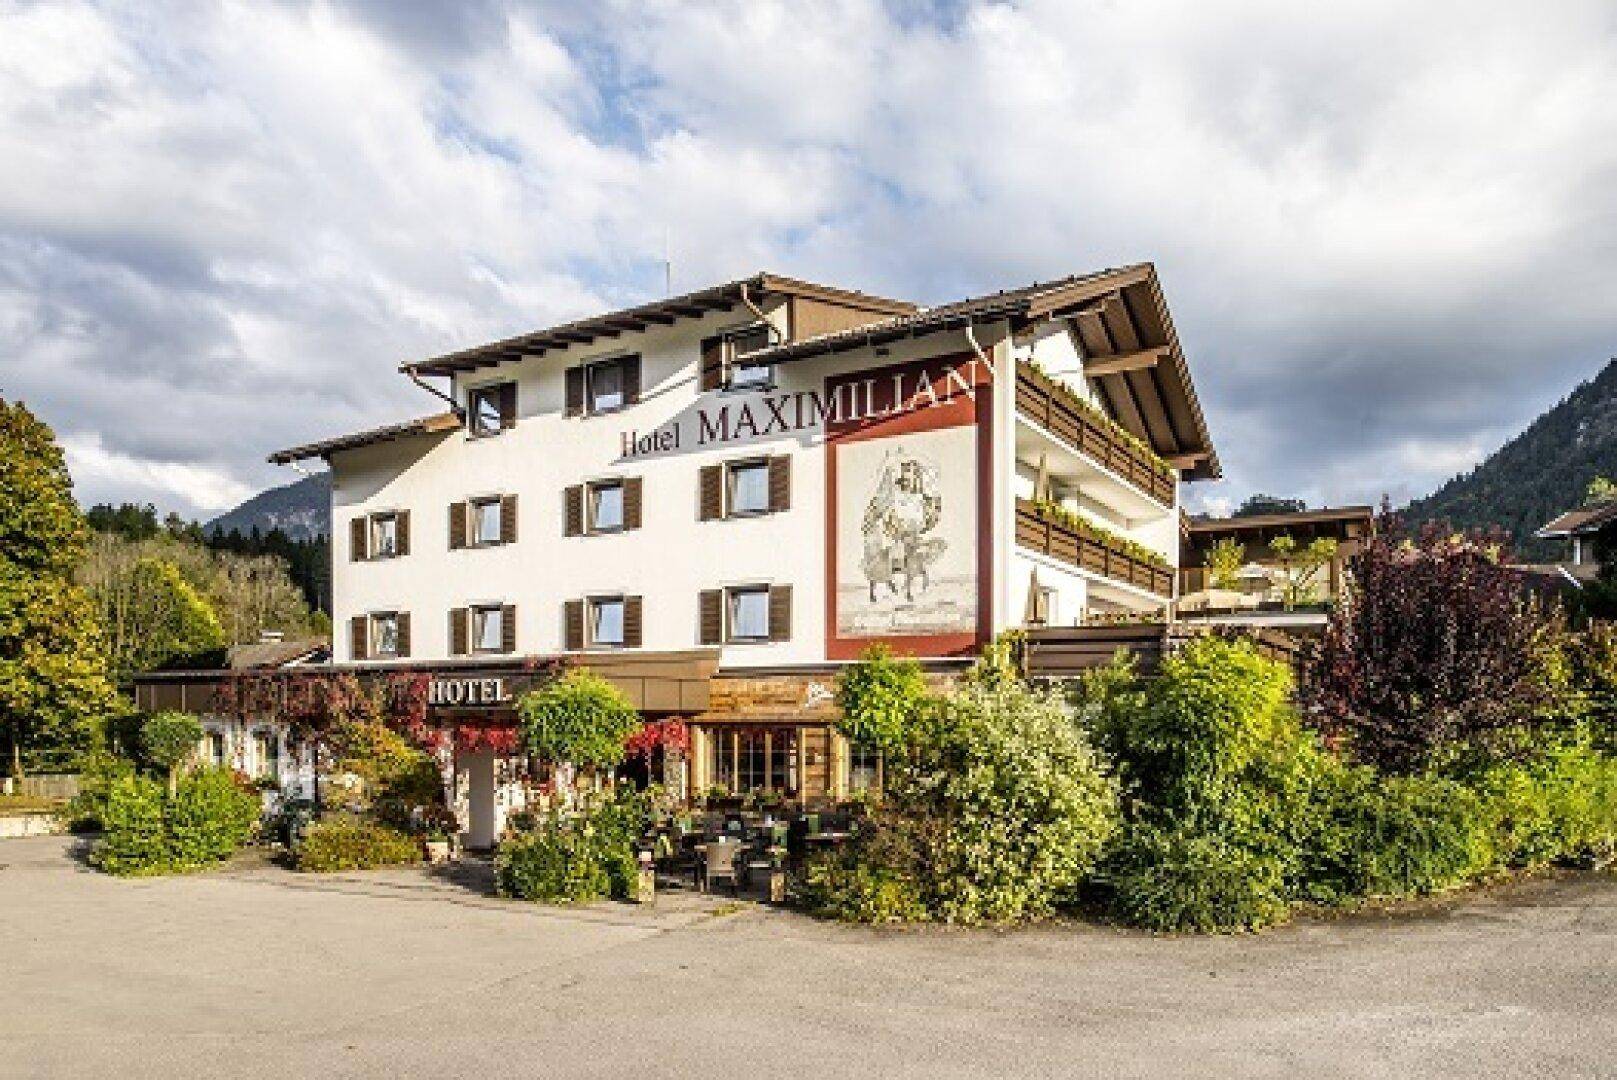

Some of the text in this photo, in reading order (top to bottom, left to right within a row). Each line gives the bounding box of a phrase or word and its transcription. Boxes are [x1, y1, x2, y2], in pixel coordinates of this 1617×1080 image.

[619, 359, 978, 458] Hotel MAXIMILIAN
[428, 678, 513, 703] HOTEL
